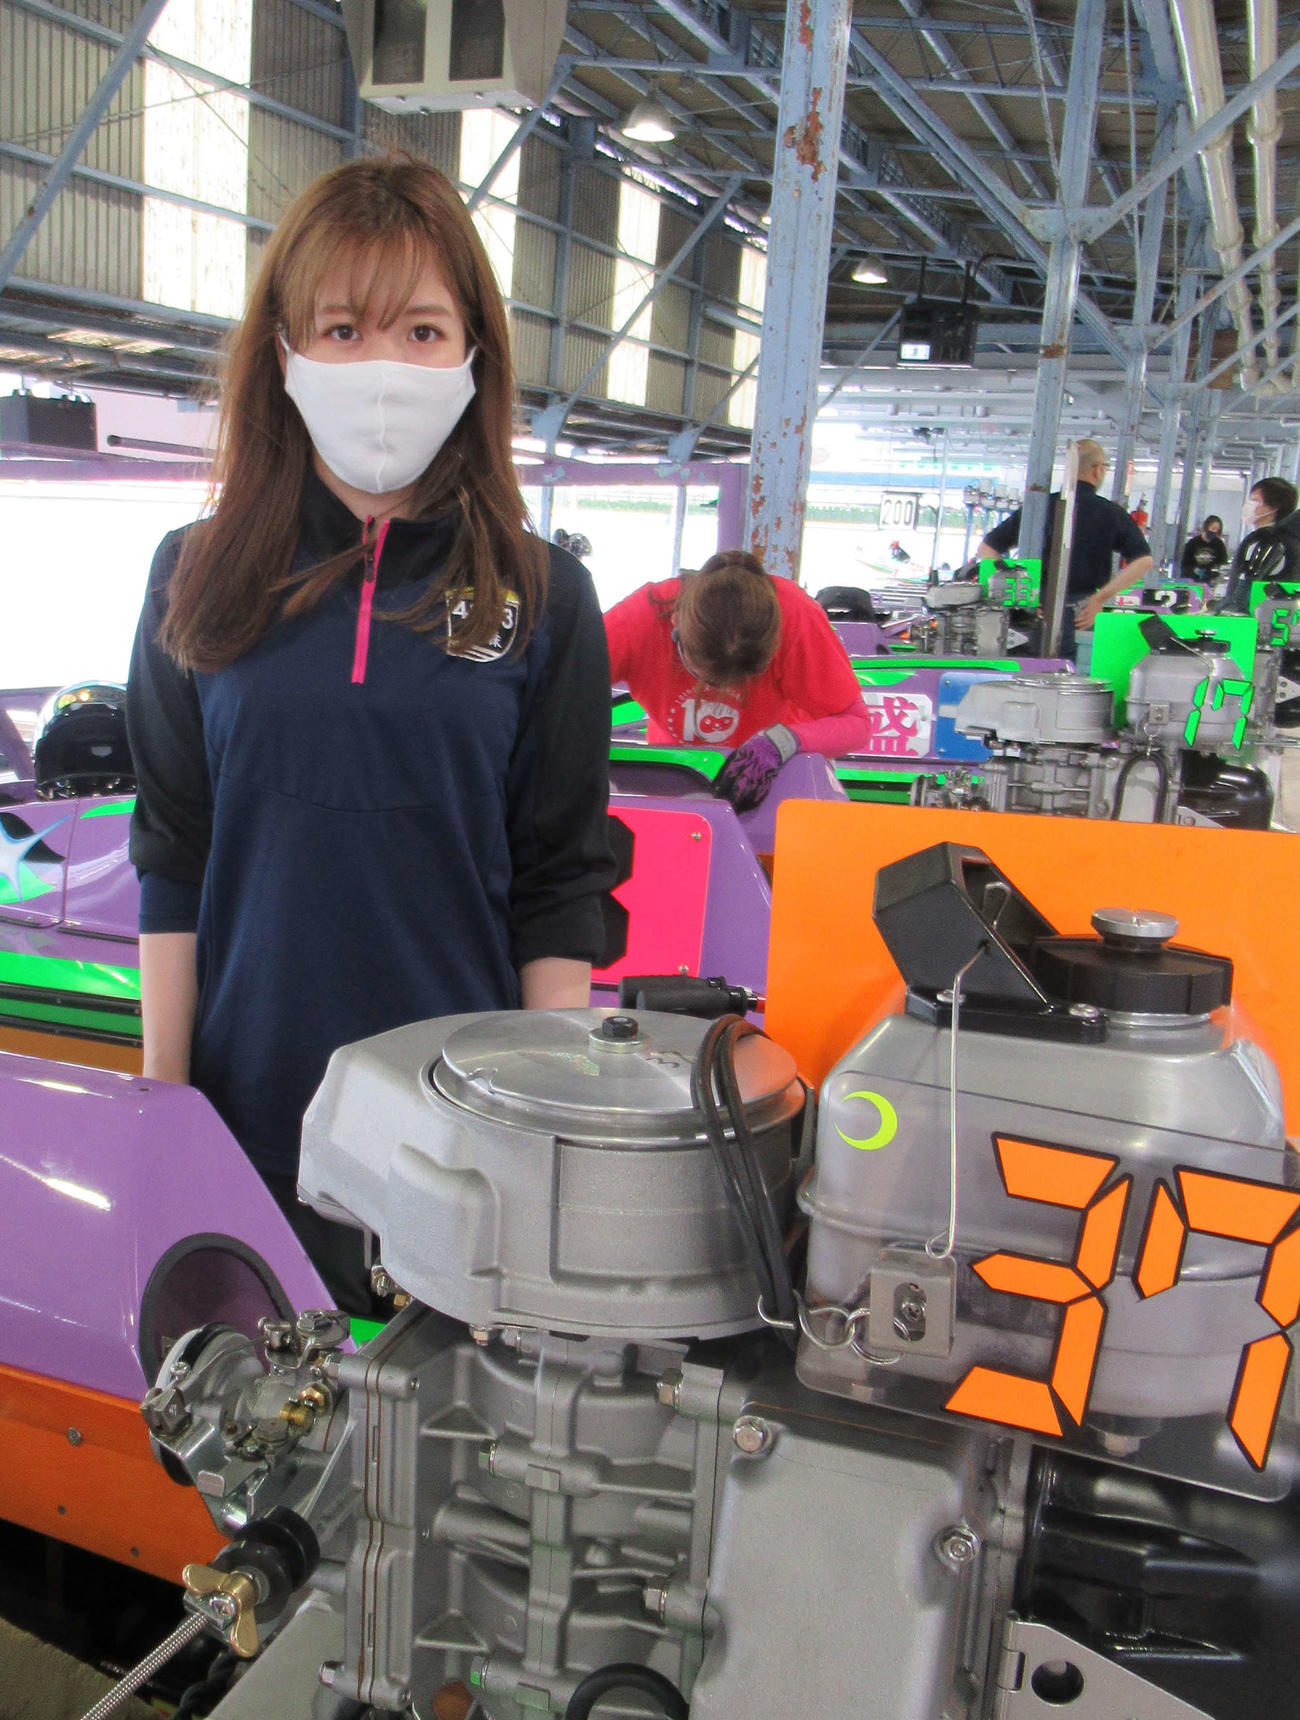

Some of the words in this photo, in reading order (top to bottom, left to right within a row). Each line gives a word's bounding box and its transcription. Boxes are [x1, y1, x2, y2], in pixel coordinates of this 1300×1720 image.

[882, 499, 914, 525] 200
[1003, 577, 1033, 606] 33
[1184, 677, 1255, 750] 17
[942, 1132, 1300, 1472] 37
